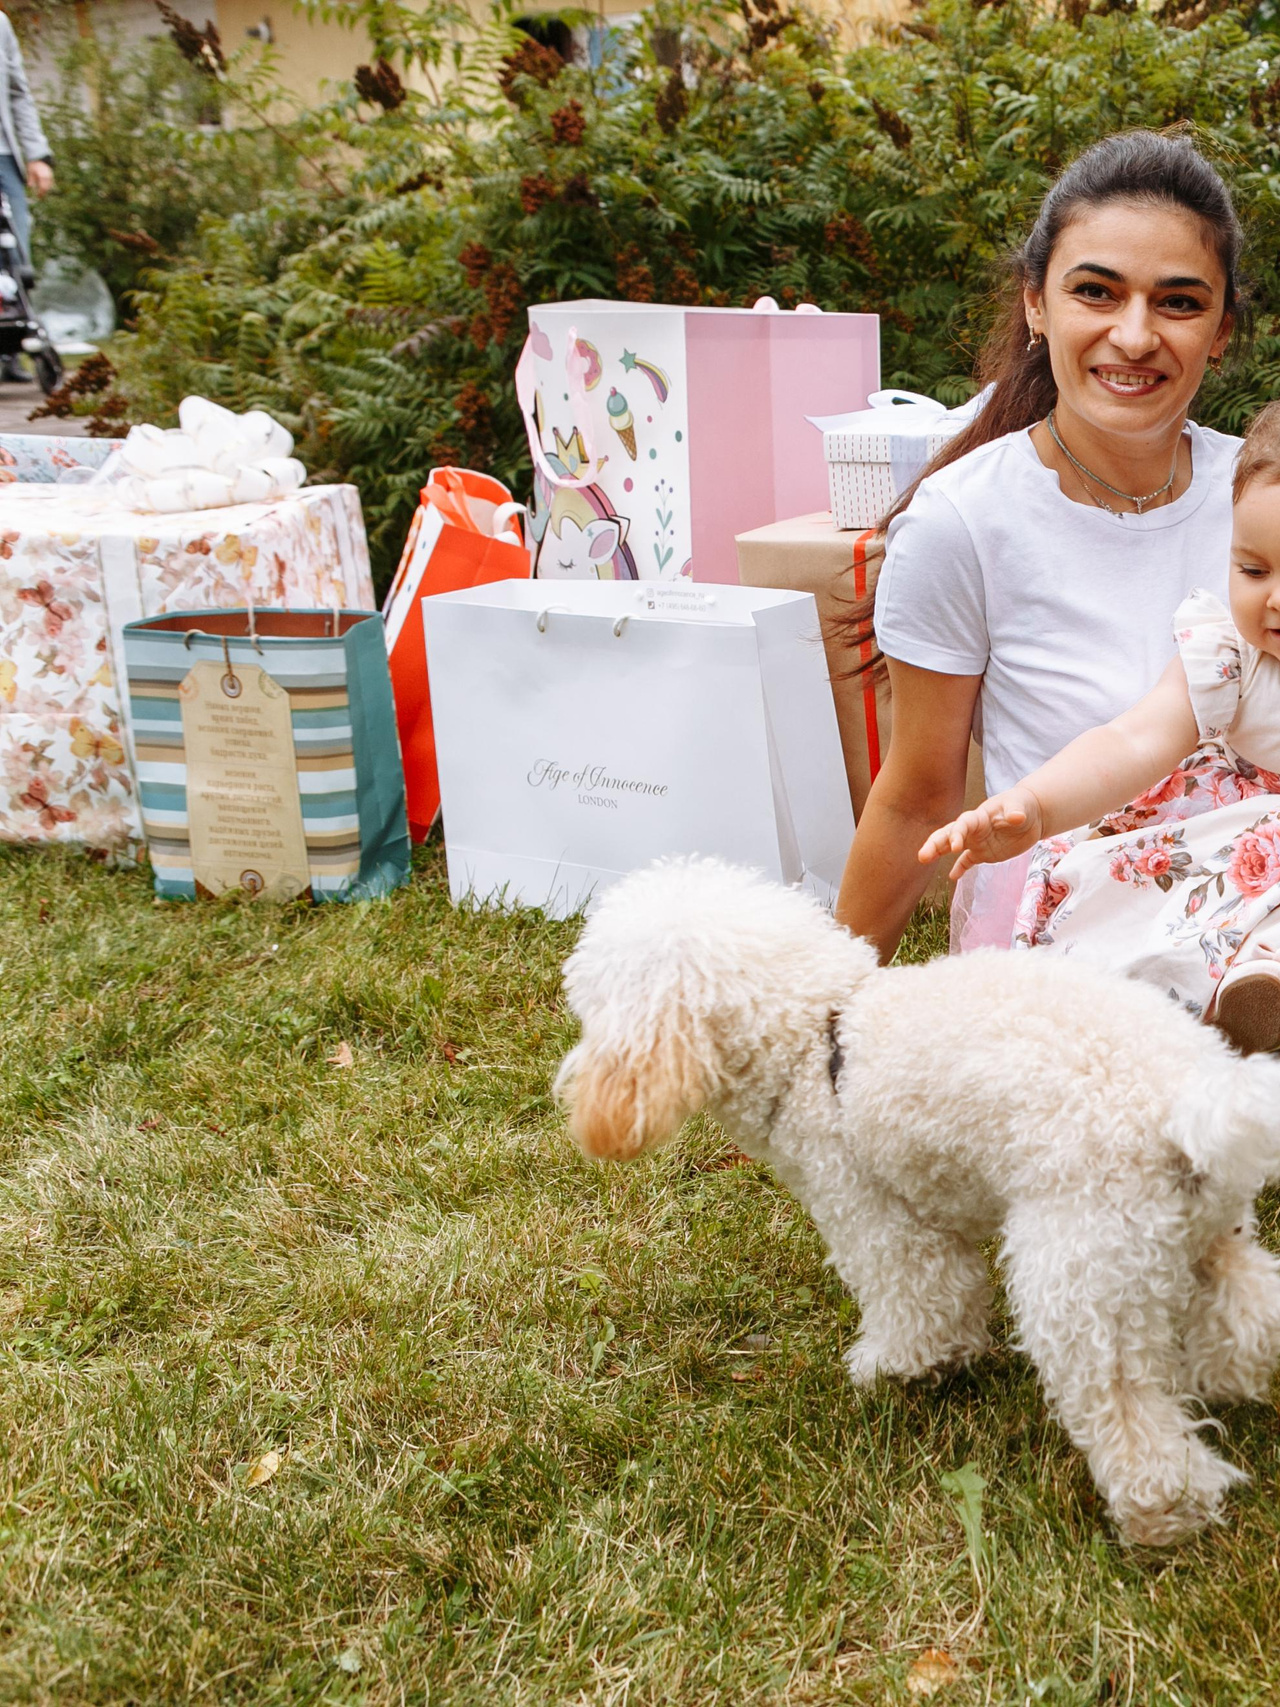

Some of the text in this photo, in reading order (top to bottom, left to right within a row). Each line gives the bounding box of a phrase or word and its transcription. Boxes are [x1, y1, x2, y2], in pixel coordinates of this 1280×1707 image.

[527, 758, 669, 797] Age of Innocence
[578, 794, 618, 809] LONDON
